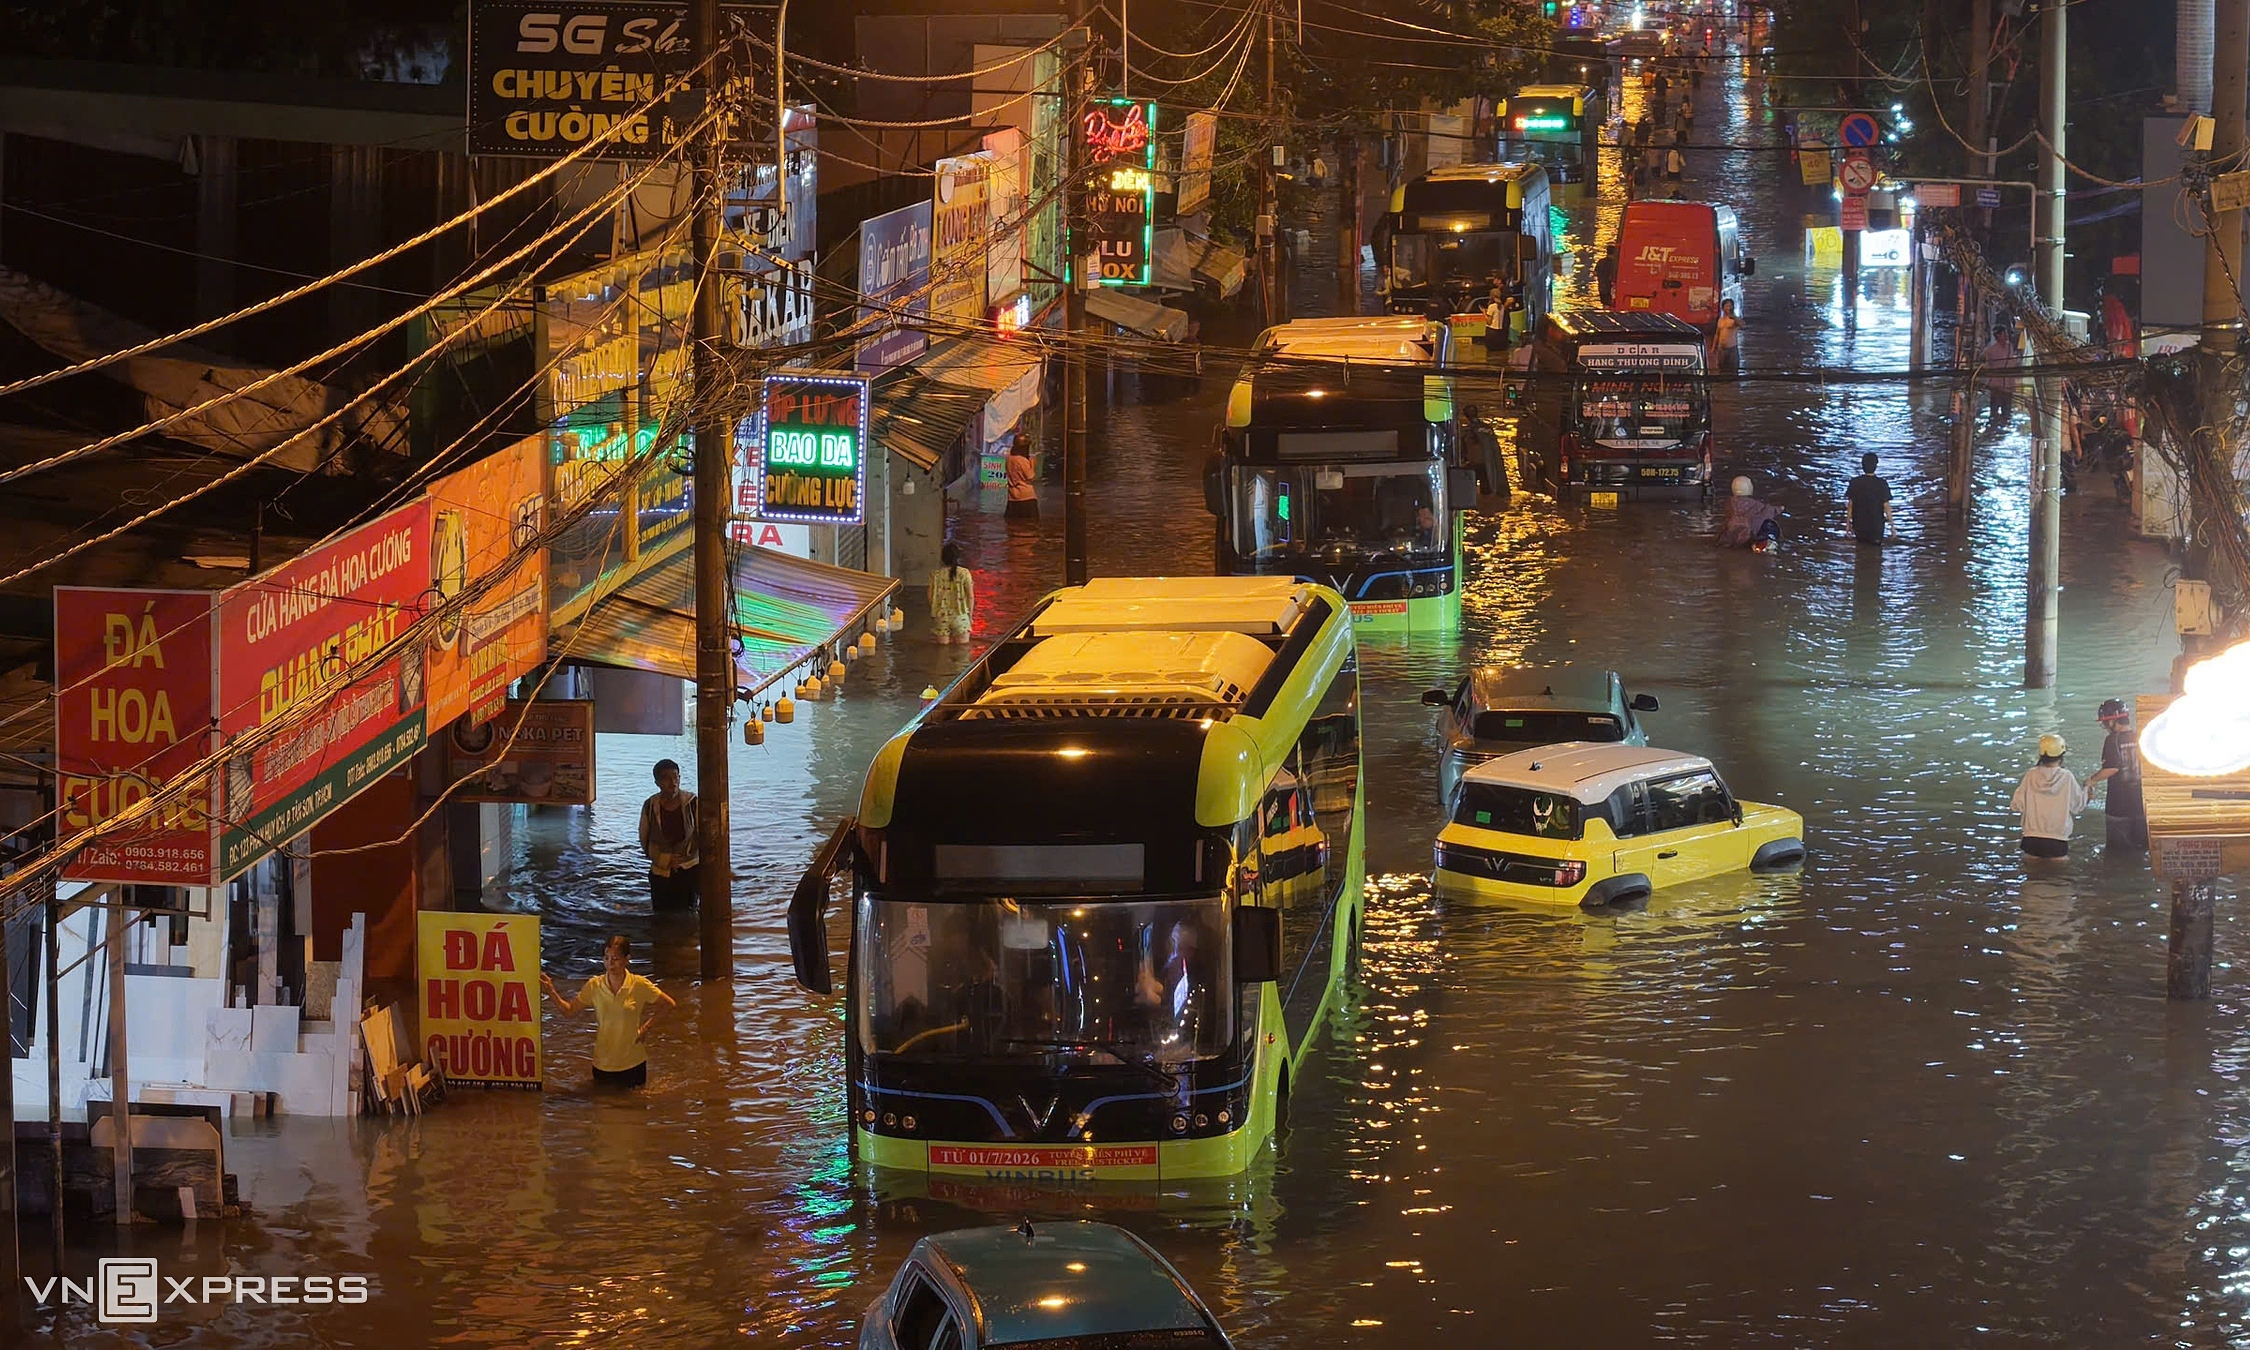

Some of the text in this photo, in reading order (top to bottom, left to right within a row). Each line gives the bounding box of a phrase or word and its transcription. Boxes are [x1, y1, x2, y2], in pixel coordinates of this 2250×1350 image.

[517, 13, 608, 55] SG
[493, 65, 653, 101] CHUYÊN
[505, 105, 649, 143] CƯỜNG
[1634, 245, 1700, 264] J&T EXPRESS
[771, 431, 853, 467] BAO DA
[765, 470, 822, 506] CƯỜNG
[825, 476, 857, 514] LỰC
[246, 526, 412, 644] CỬA HÀNG ĐÁ HOA CƯƠNG
[103, 601, 165, 669] ĐÁ
[260, 631, 341, 727] QUANG
[345, 596, 399, 667] PHÁT
[91, 688, 177, 743] HOA
[63, 766, 207, 832] CƯƠNG
[125, 846, 205, 861] 0903.918.656
[443, 922, 516, 972] ĐÁ
[427, 979, 532, 1022] HOA
[427, 1029, 535, 1078] CƯƠNG
[941, 1148, 965, 1163] TỪ
[969, 1150, 1040, 1166] 01/7/2026
[1107, 1157, 1143, 1165] TICKET
